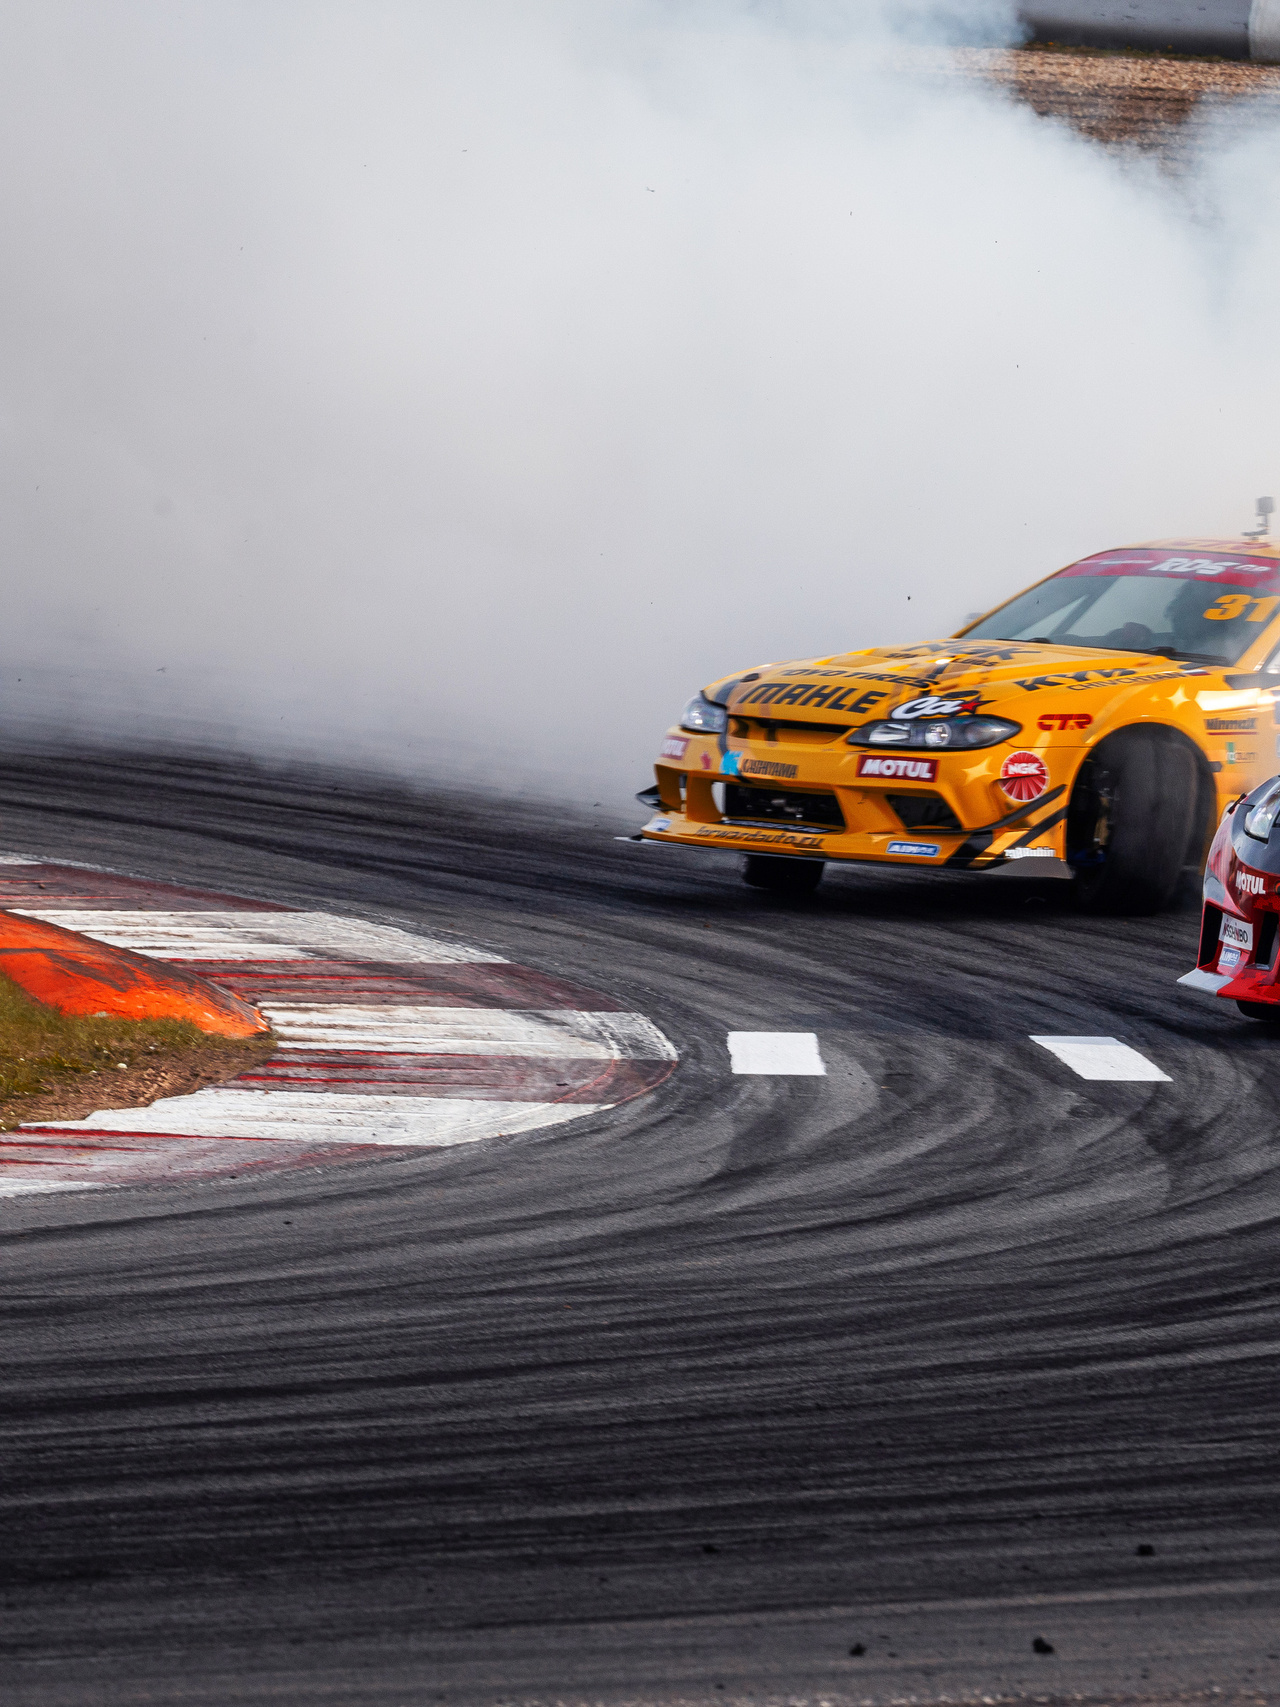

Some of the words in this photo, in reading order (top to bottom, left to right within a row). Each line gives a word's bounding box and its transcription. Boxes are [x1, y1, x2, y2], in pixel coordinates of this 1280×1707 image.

[1148, 557, 1243, 575] RDS
[1013, 668, 1137, 691] KYB
[738, 683, 890, 714] MAHLE
[1037, 714, 1093, 731] CTR
[861, 759, 934, 779] MOTUL
[1008, 763, 1041, 775] NGK
[1236, 870, 1266, 895] MOTUL
